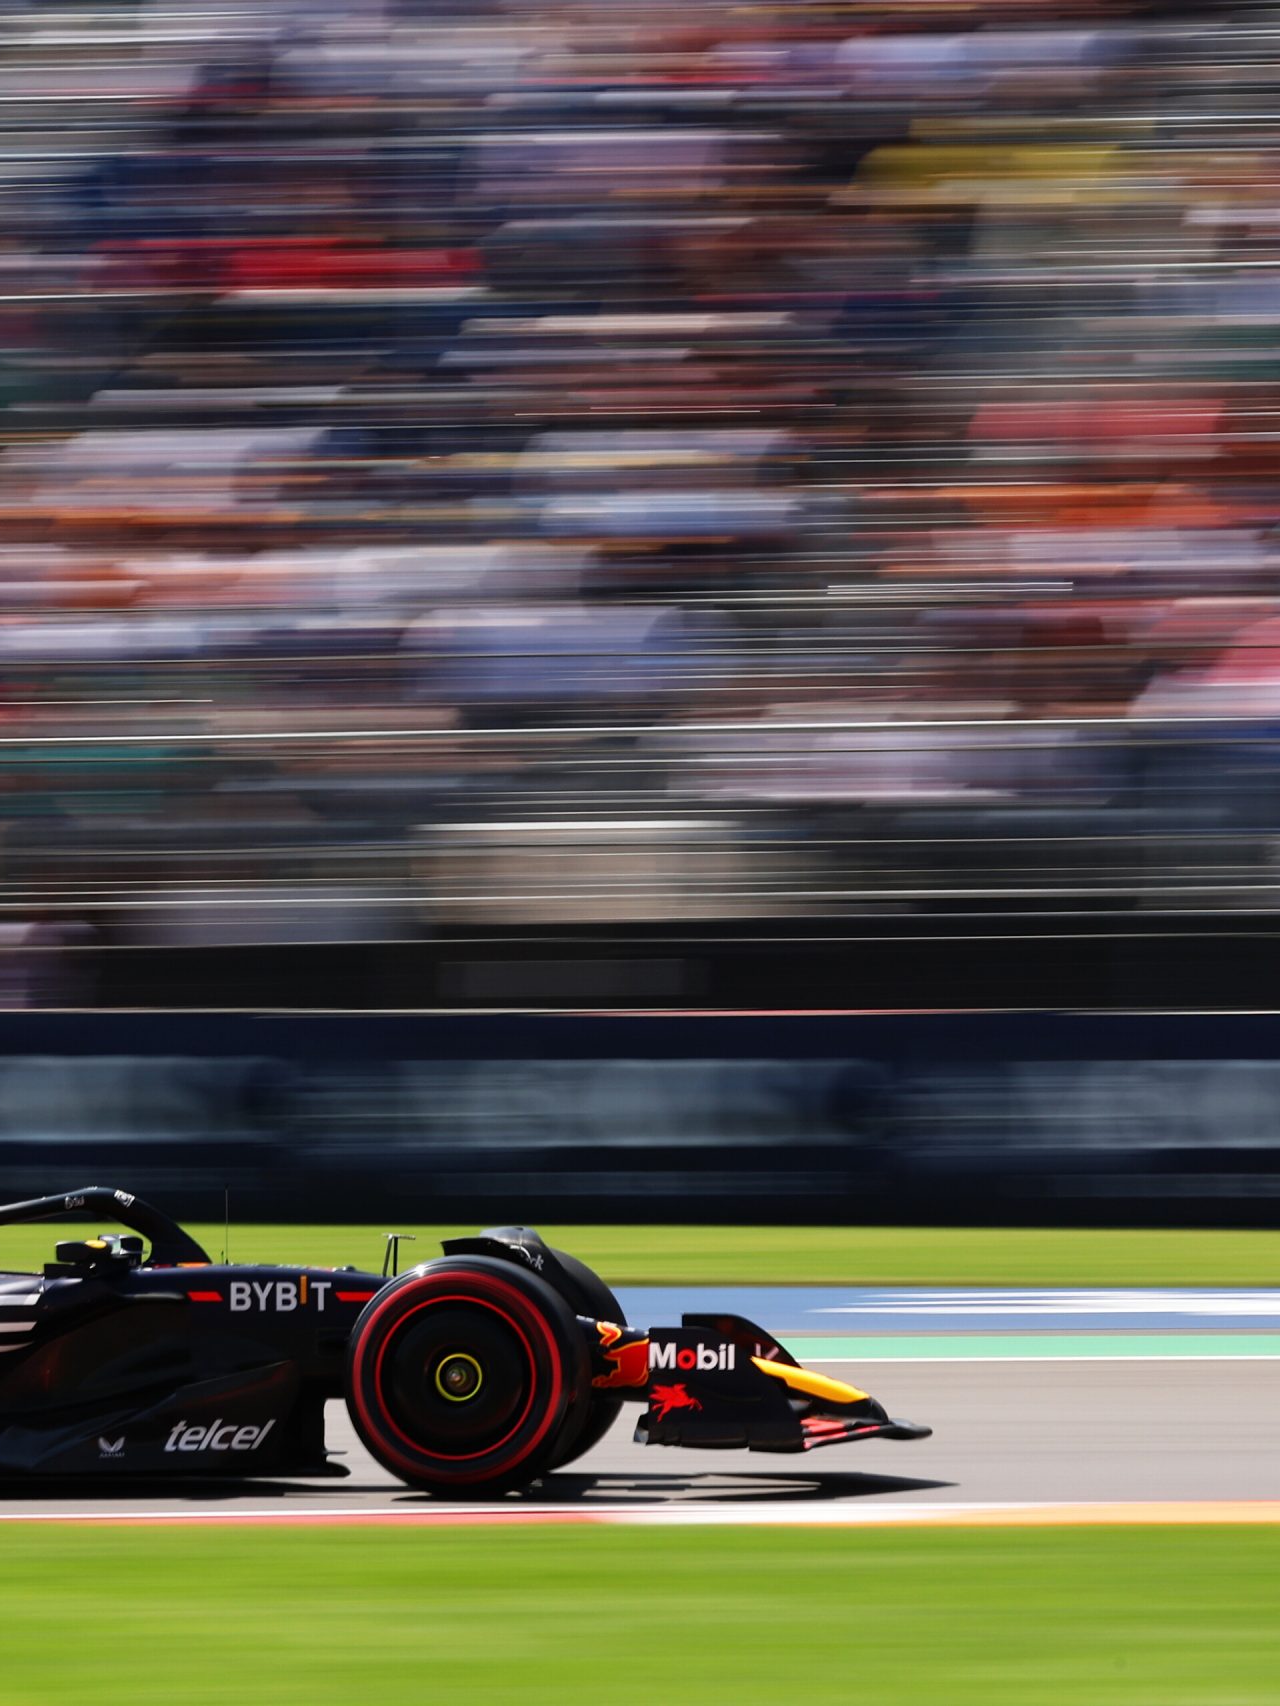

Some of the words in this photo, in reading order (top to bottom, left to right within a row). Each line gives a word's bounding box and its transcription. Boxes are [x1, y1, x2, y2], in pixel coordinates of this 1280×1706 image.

[230, 1275, 332, 1311] BYBIT
[648, 1342, 736, 1371] Mobil
[163, 1418, 277, 1452] telcel
